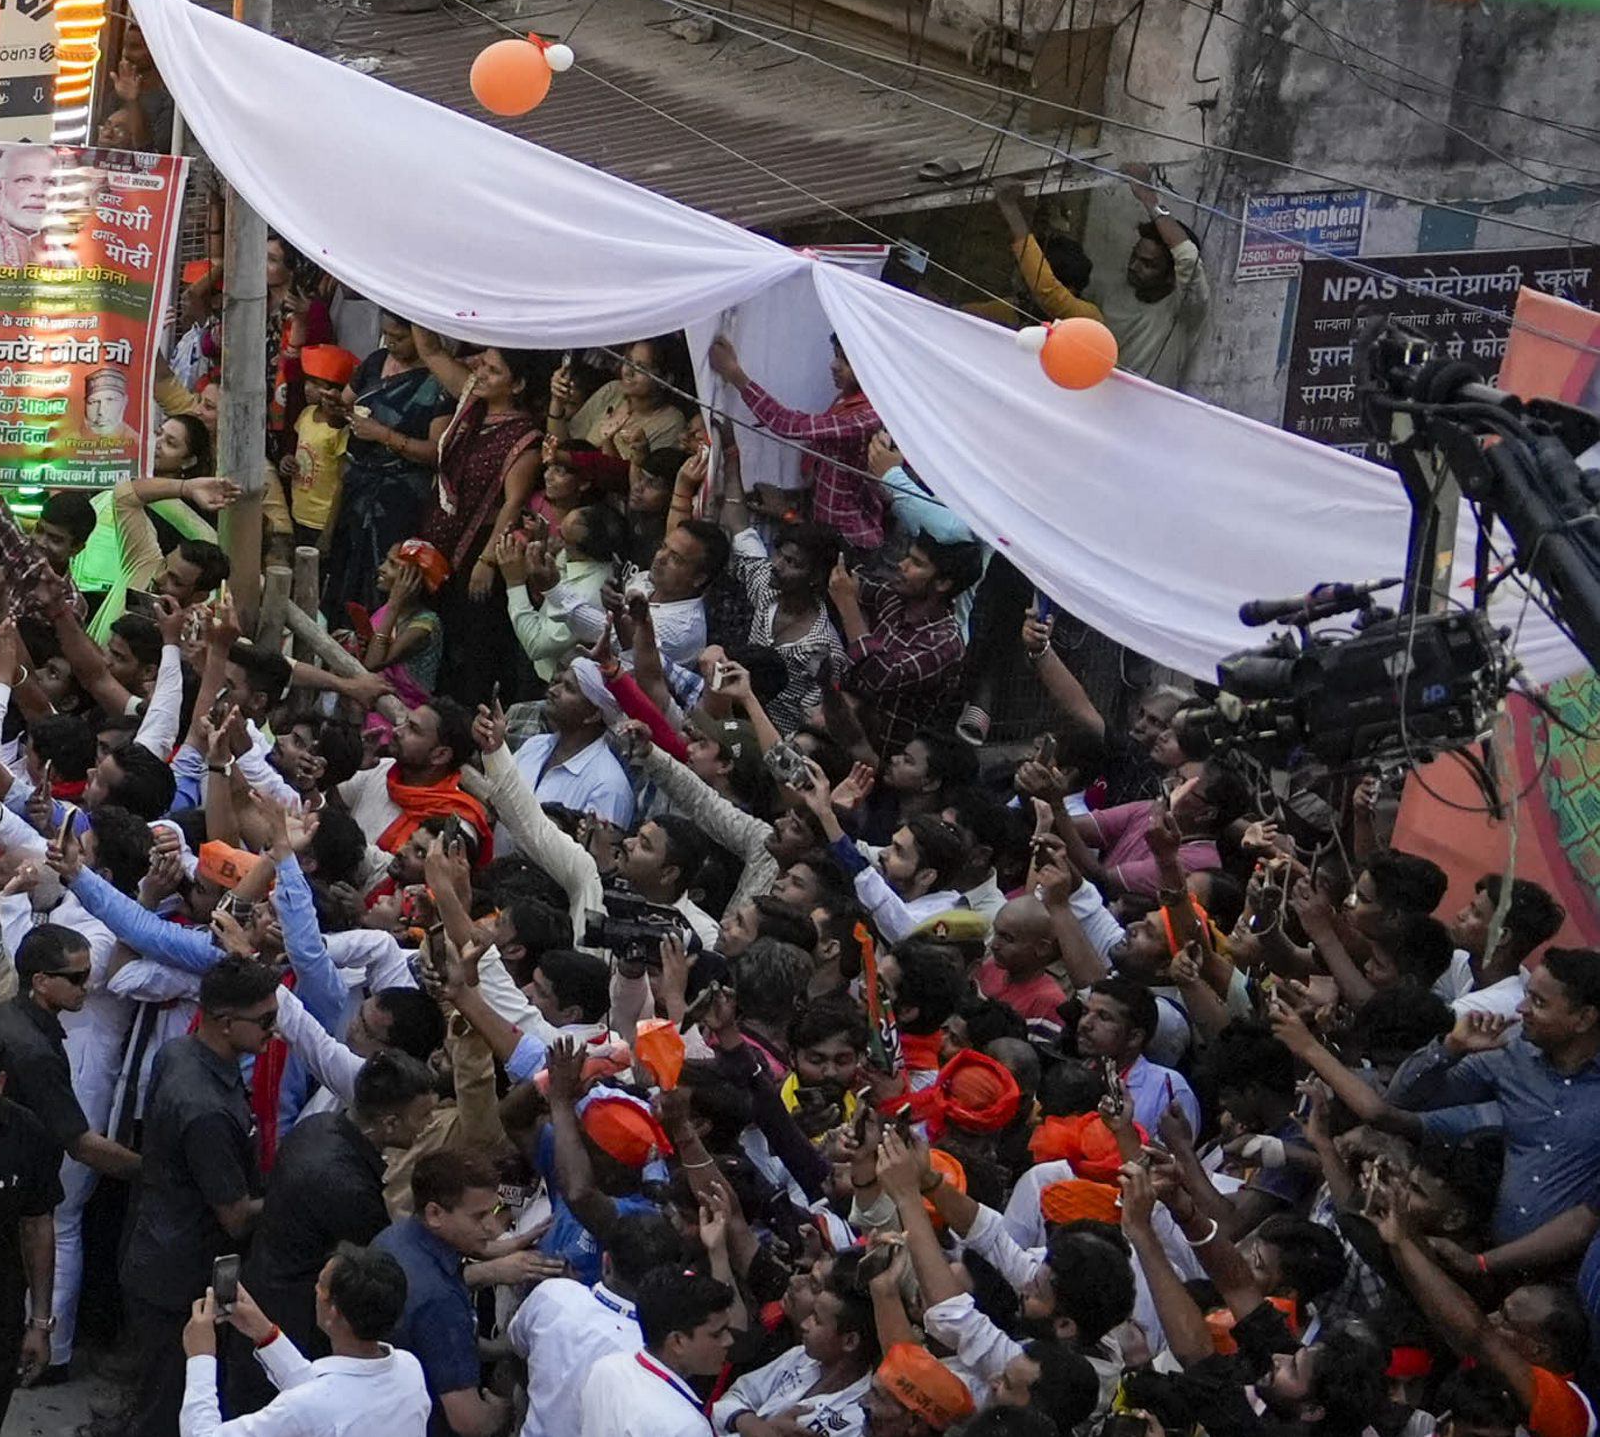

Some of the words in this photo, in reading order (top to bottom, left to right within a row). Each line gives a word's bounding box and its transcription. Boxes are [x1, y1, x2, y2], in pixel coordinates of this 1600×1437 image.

[96, 205, 153, 232] काशी
[1293, 204, 1362, 231] Spoken
[1320, 228, 1359, 241] English
[105, 241, 153, 271] मोदी
[1275, 249, 1301, 264] Only
[1321, 275, 1399, 302] NPAS
[1404, 264, 1524, 298] फोटोग्राफी
[1445, 332, 1466, 360] से
[1300, 374, 1357, 406] सम्पर्क
